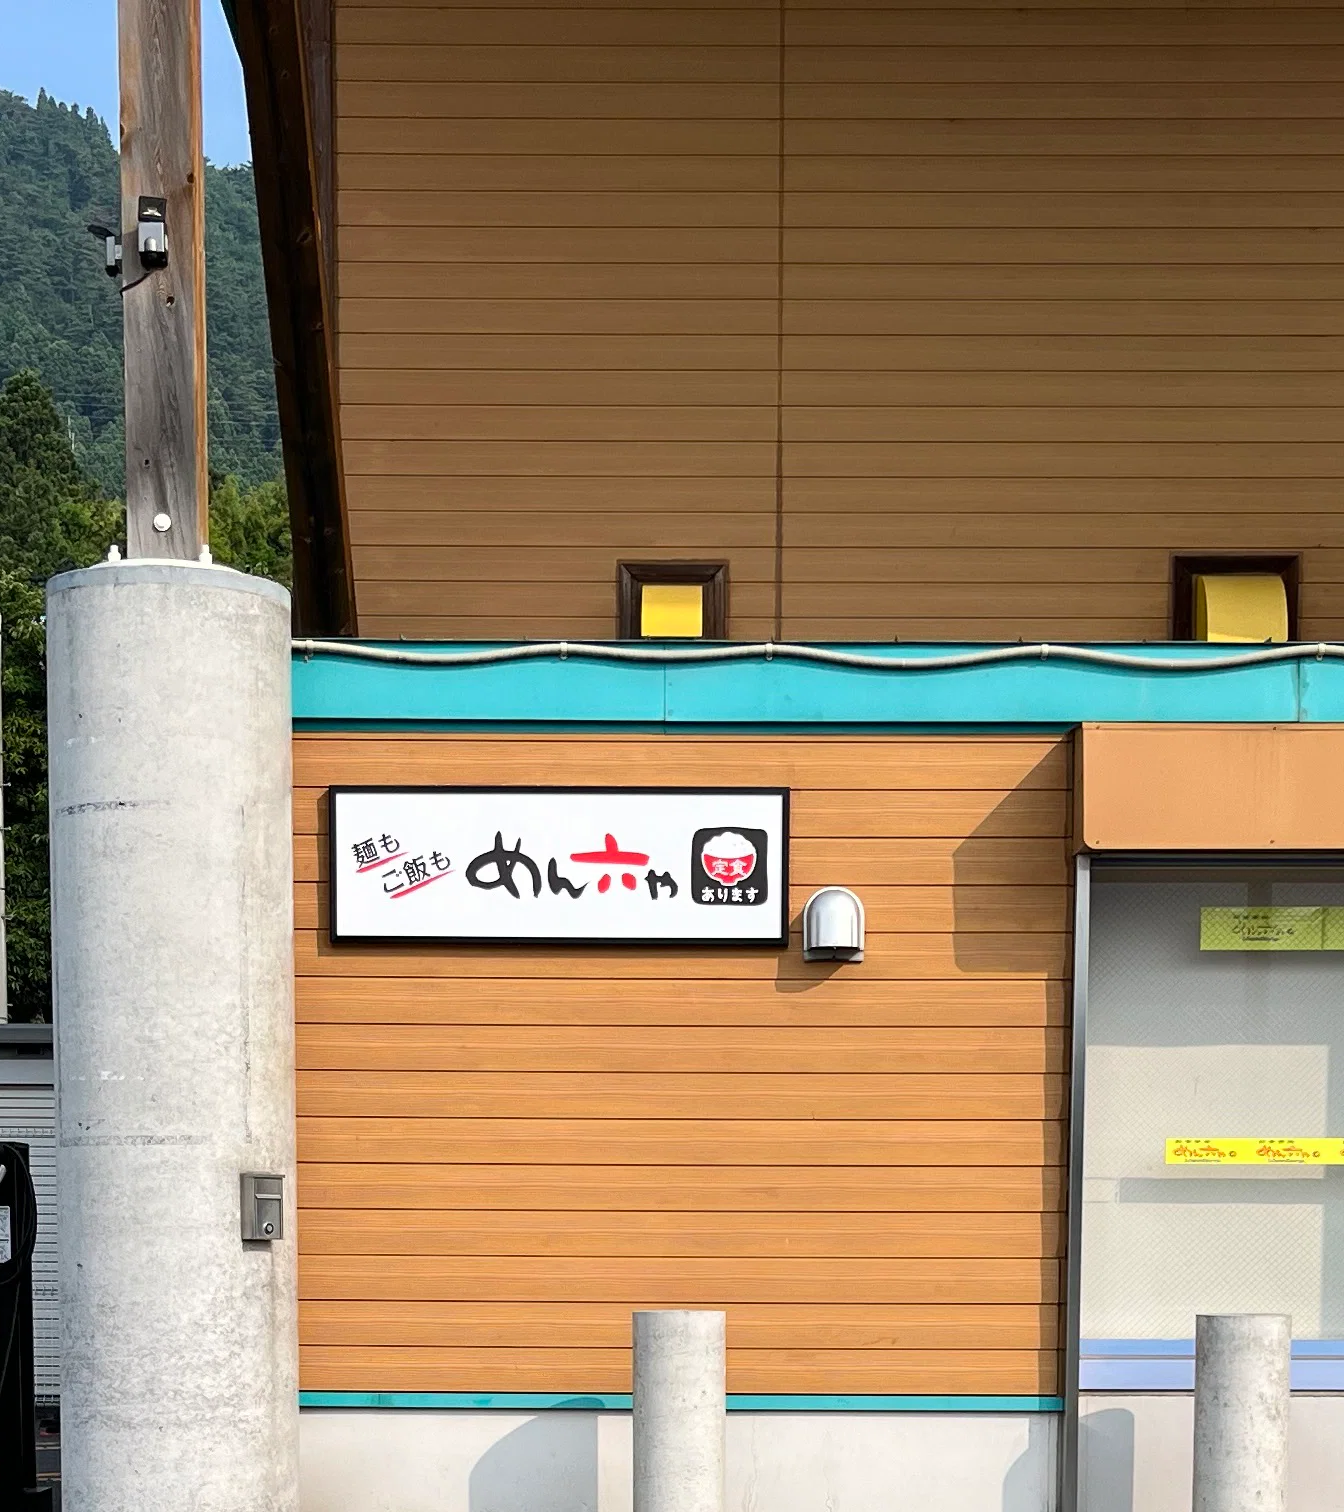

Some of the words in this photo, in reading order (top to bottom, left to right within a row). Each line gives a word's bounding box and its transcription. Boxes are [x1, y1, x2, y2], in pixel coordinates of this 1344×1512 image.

[351, 833, 401, 868] 麺も
[465, 830, 678, 900] めん六や
[711, 859, 747, 877] 定食
[381, 851, 451, 893] ご飯も
[701, 886, 759, 903] あります
